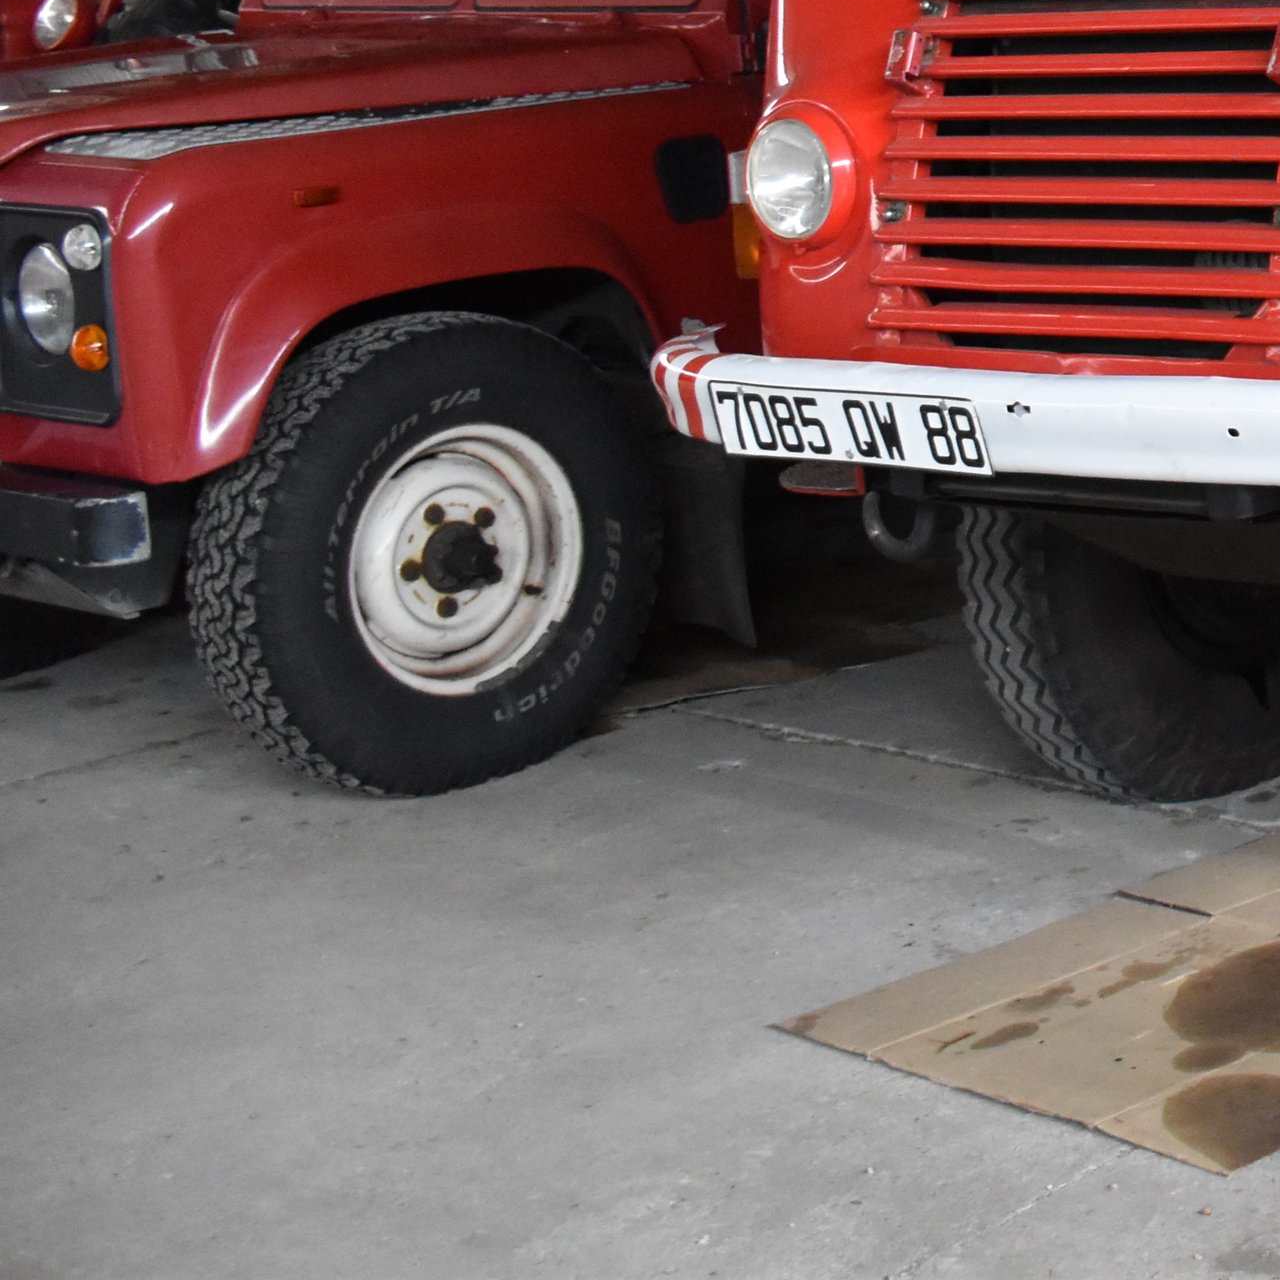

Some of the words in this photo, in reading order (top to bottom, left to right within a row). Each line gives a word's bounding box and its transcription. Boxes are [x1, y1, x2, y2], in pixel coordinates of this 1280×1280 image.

[429, 387, 482, 415] T/A
[716, 391, 832, 455] 7085
[842, 399, 906, 461] QW
[919, 404, 985, 468] 88
